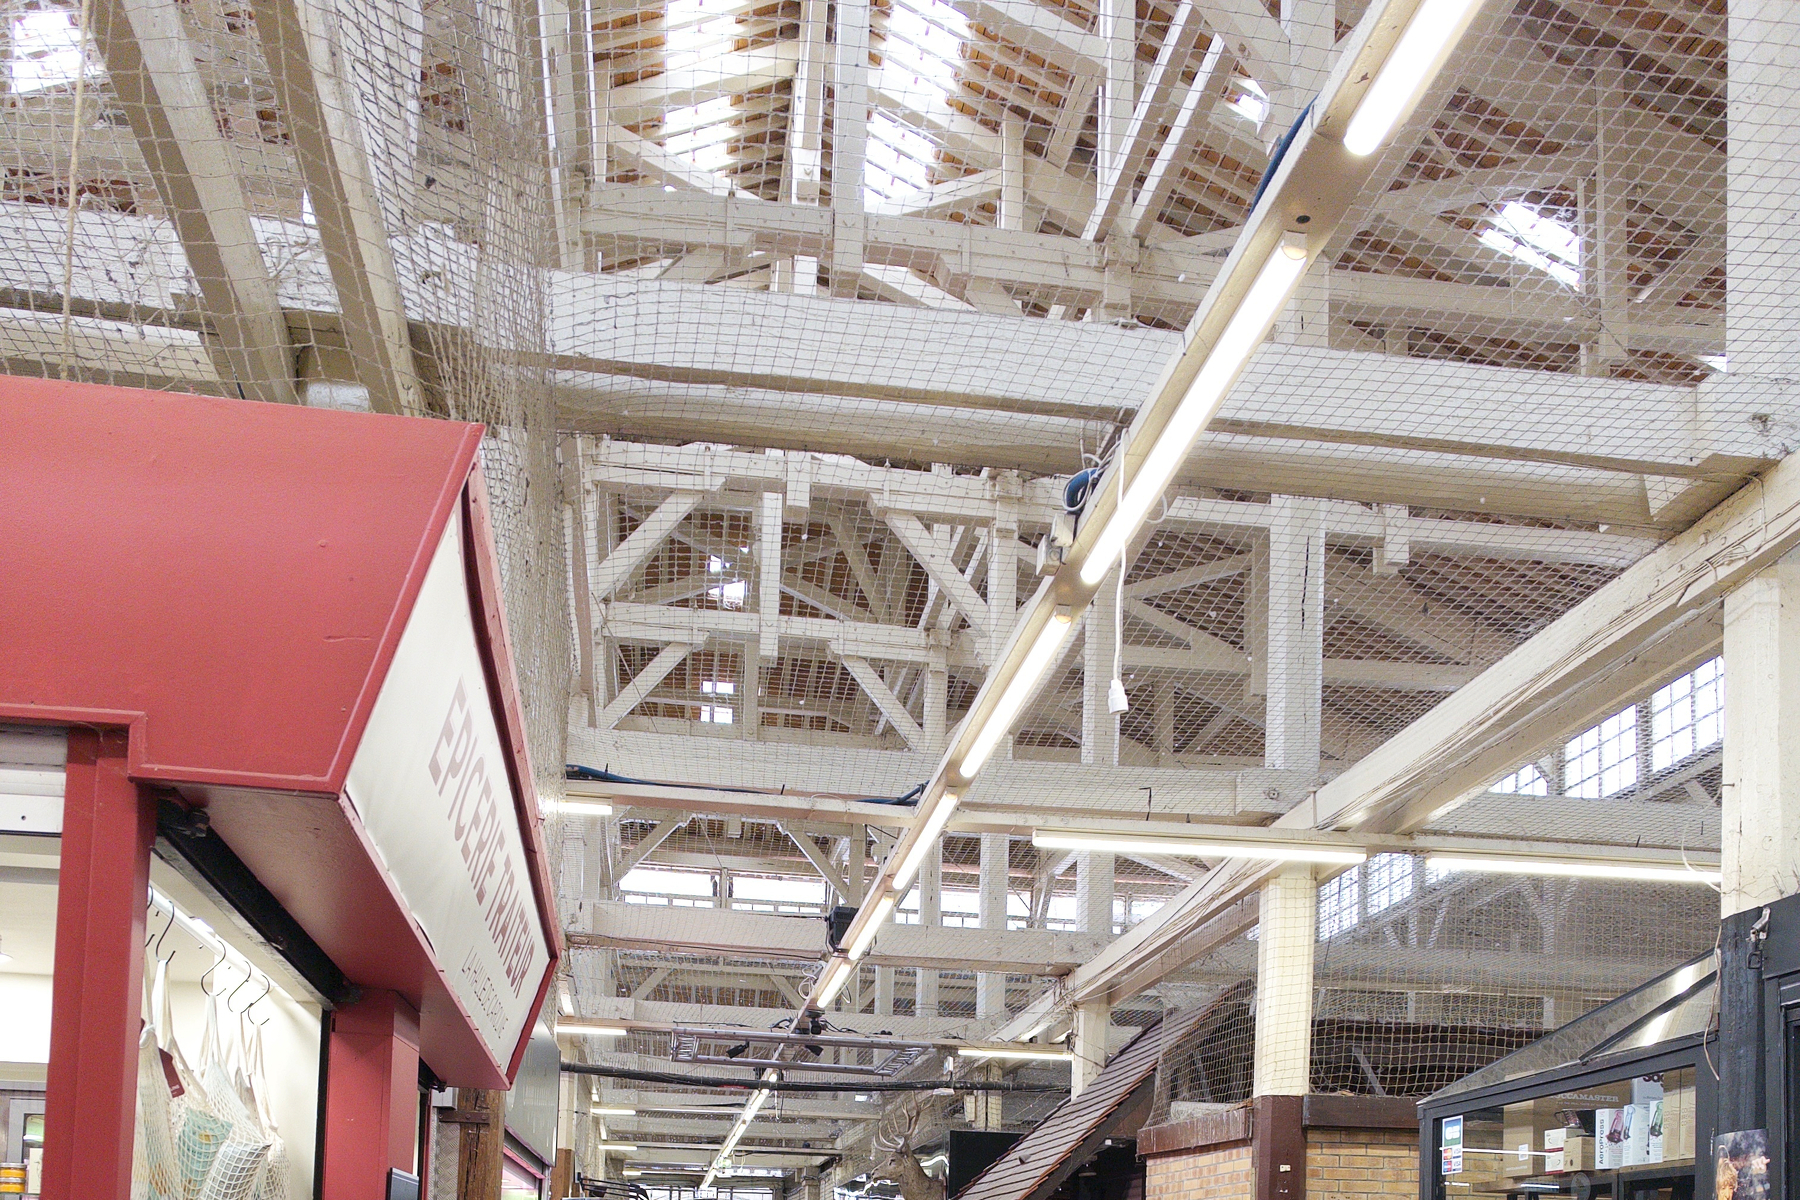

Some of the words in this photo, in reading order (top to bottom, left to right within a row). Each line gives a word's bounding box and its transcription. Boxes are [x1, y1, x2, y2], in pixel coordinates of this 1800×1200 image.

[428, 673, 507, 907] EPICERIE
[484, 851, 537, 1000] TRAITEUR
[1548, 1092, 1620, 1103] OCCAMASTER
